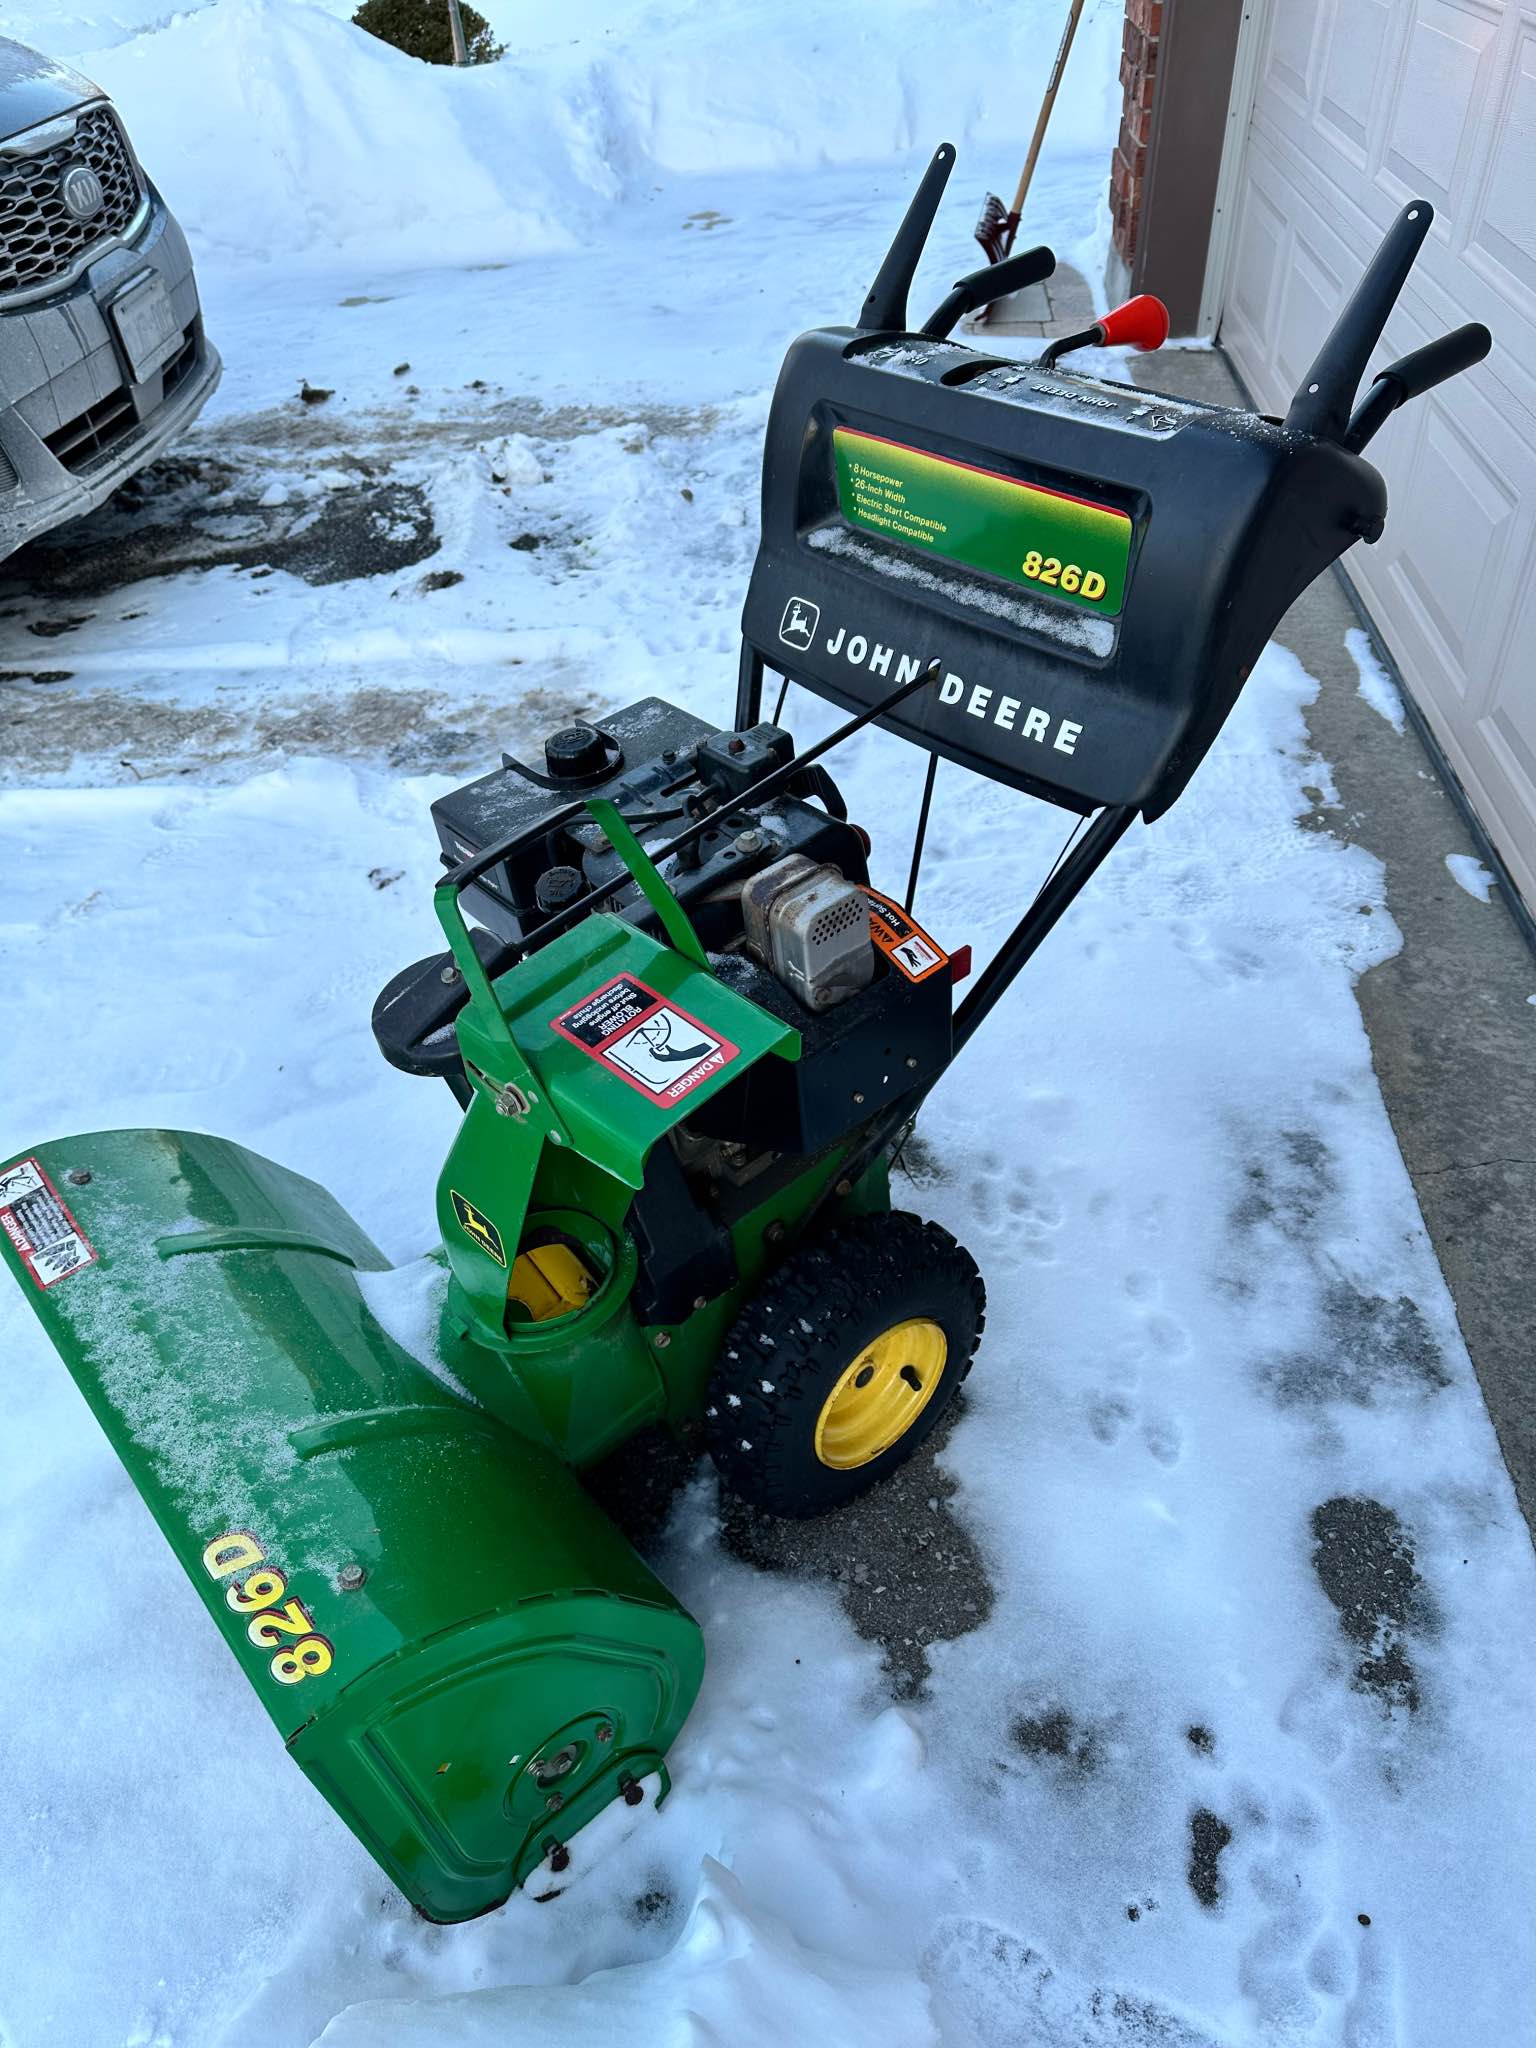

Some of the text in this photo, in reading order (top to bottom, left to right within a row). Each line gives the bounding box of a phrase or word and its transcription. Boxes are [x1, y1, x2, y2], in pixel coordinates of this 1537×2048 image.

[1030, 383, 1118, 408] JOHN DEERE
[853, 463, 904, 488] 8 Horsepower
[854, 477, 906, 503] 26-Inch Width
[856, 493, 947, 533] Electric Start Compatible
[857, 507, 934, 542] Headlight Compatible
[1021, 550, 1107, 601] 826D
[826, 628, 1083, 755] JOHN DEERE
[868, 898, 887, 914] Surfa
[885, 912, 900, 927] Hot
[591, 983, 623, 1007] discharge
[608, 987, 631, 1004] before
[571, 1002, 609, 1029] unclogging
[572, 1005, 592, 1020] chute
[588, 992, 638, 1026] Shut off engine
[598, 1004, 634, 1030] BLOWER
[601, 1006, 643, 1036] ROTATING
[667, 1062, 714, 1098] DANGER
[1, 1211, 28, 1249] DANGER
[202, 1528, 335, 1686] 826D
